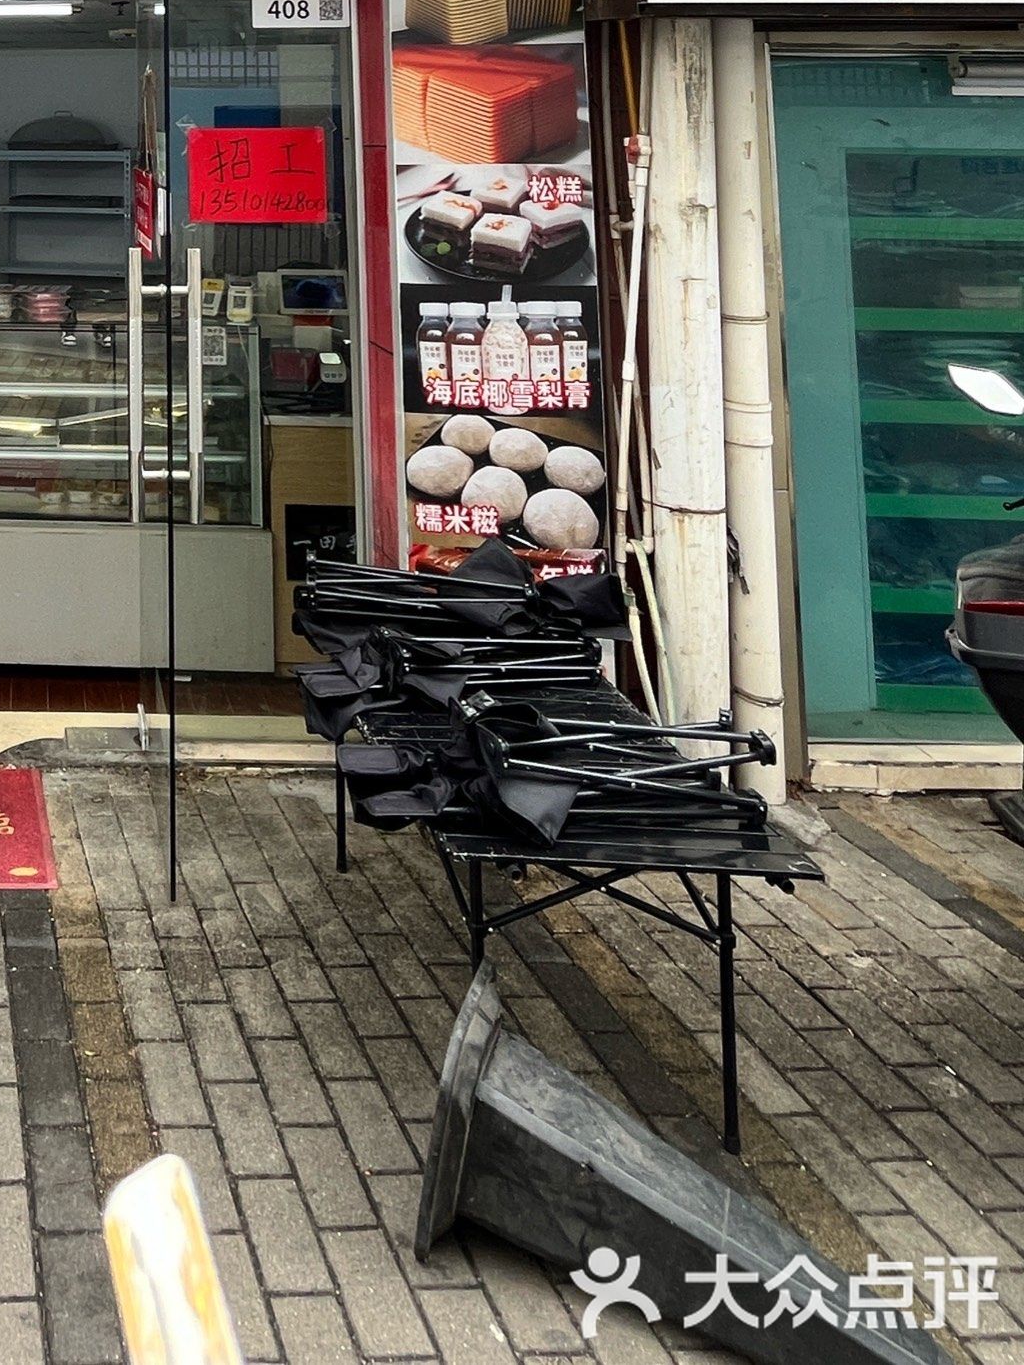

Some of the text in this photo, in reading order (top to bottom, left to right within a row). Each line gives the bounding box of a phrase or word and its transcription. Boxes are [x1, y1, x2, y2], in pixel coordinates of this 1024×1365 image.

[268, 0, 310, 19] 408
[208, 138, 316, 183] 招工
[529, 176, 582, 202] 松糕
[427, 379, 590, 409] 海底椰雪梨膏
[415, 504, 499, 535] 糯米糍
